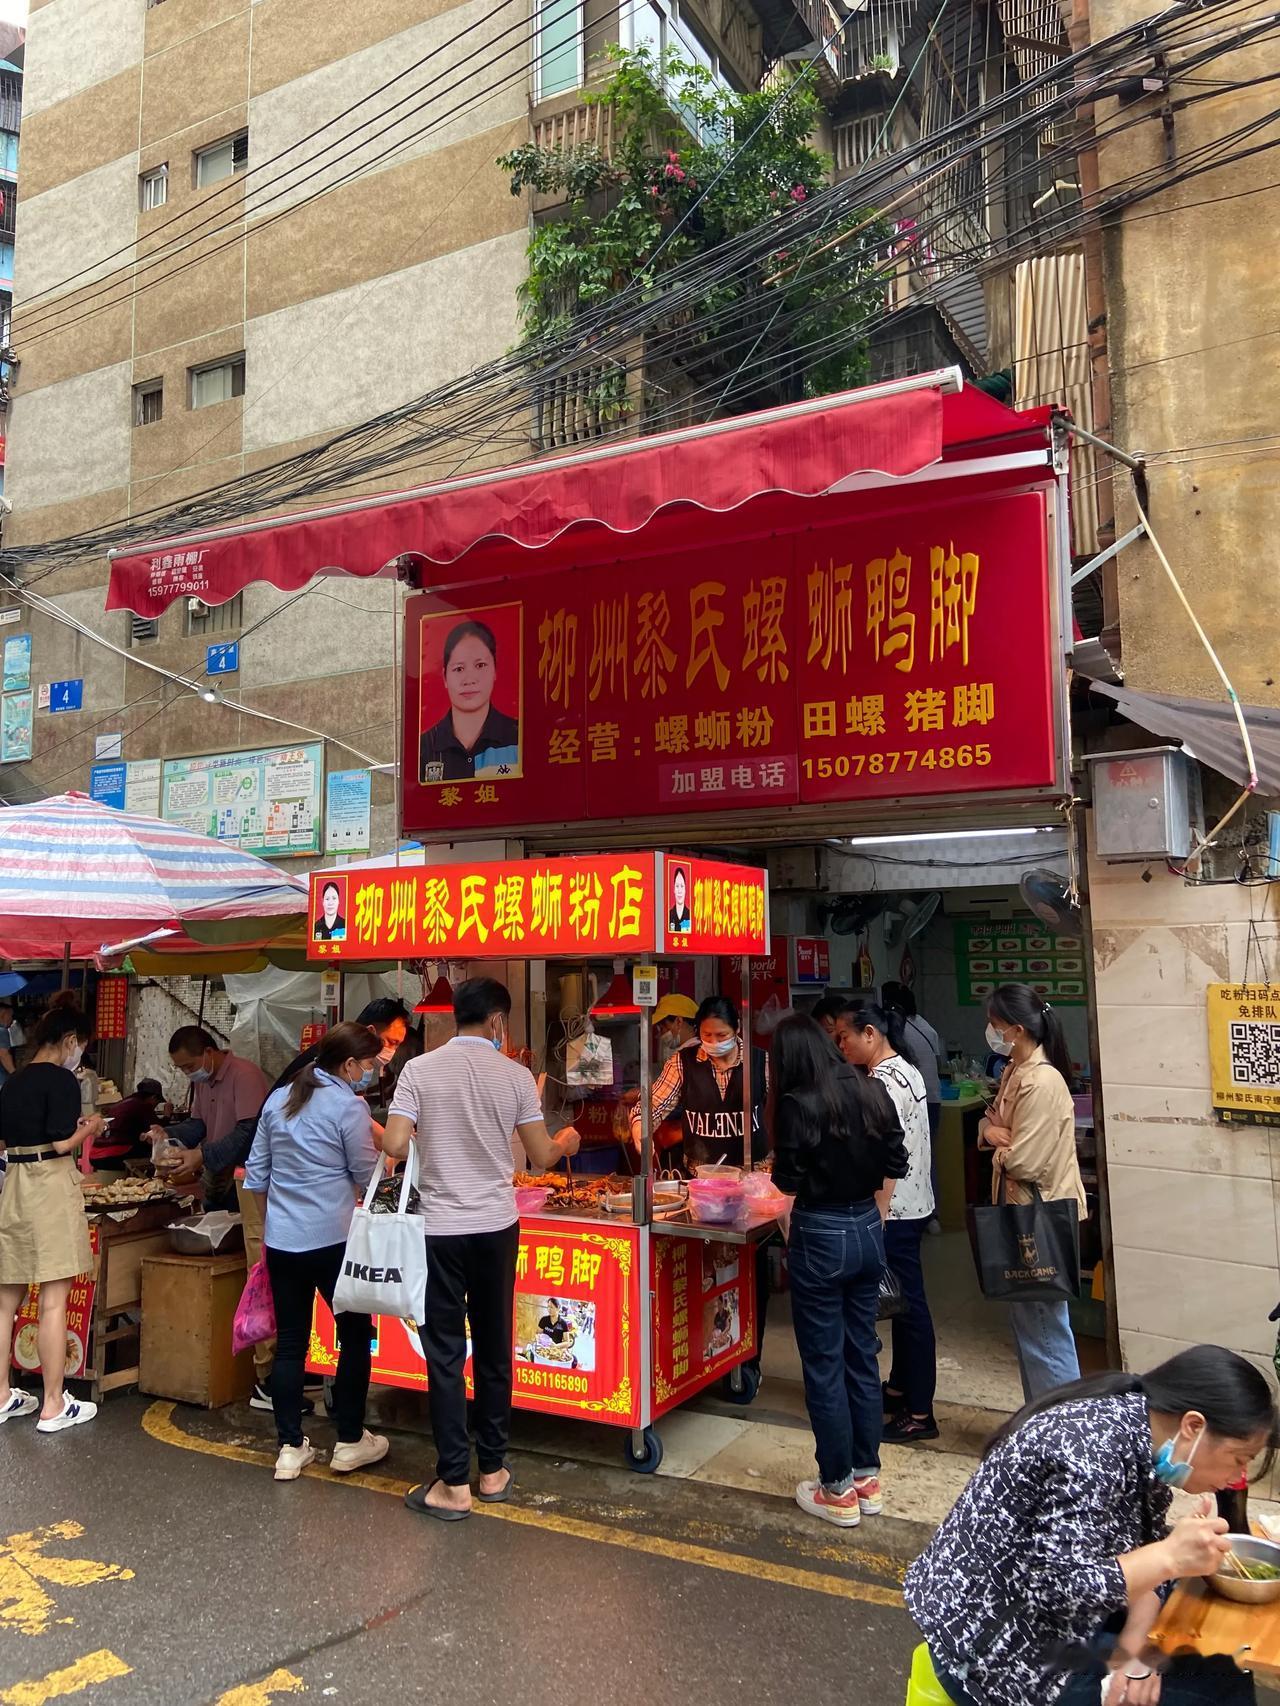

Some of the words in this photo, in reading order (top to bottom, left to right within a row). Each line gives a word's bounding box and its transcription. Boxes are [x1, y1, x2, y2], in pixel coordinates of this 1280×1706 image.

[148, 580, 209, 597] 15977799011
[539, 540, 979, 710] 柳州黎氏螺蛳鸭脚
[219, 656, 226, 669] 4
[62, 690, 70, 703] 4
[803, 694, 886, 738] 田螺
[904, 683, 995, 732] 猪脚
[671, 761, 786, 794] 加盟电话
[802, 743, 992, 779] 15078774865
[355, 865, 643, 946] 柳州黎氏螺蛳粉店
[1238, 1005, 1278, 1018] 免排队
[344, 1260, 402, 1283] IKEA
[516, 1367, 588, 1394] 15361165890
